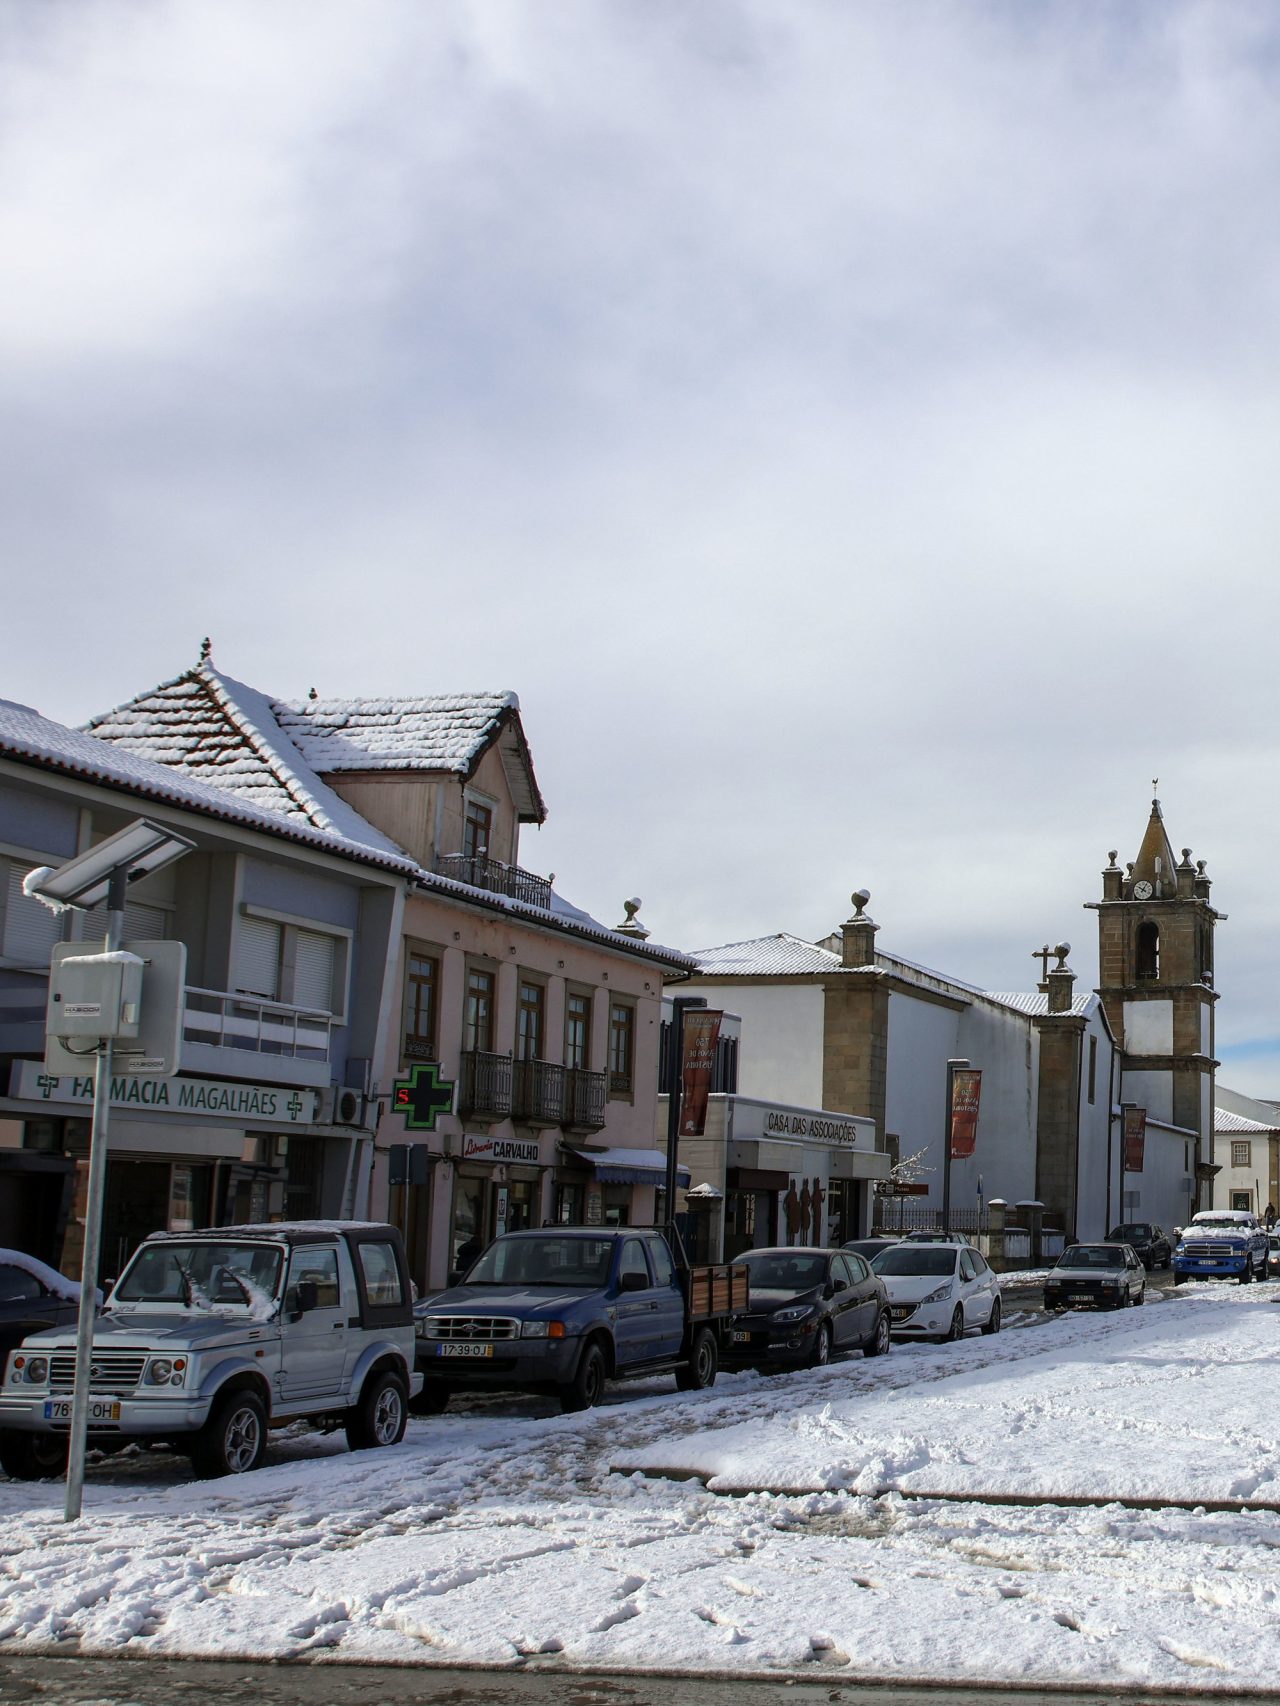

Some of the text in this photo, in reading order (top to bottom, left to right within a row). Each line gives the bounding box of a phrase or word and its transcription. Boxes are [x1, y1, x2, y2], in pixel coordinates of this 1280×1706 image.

[72, 1076, 278, 1116] FAMÁCIA MAGALHÃES
[398, 1089, 409, 1105] S
[768, 1112, 856, 1144] CASA DAS ASSOCIAÇÕES
[493, 1141, 538, 1161] CARVALHO
[53, 1402, 112, 1418] 76--OH
